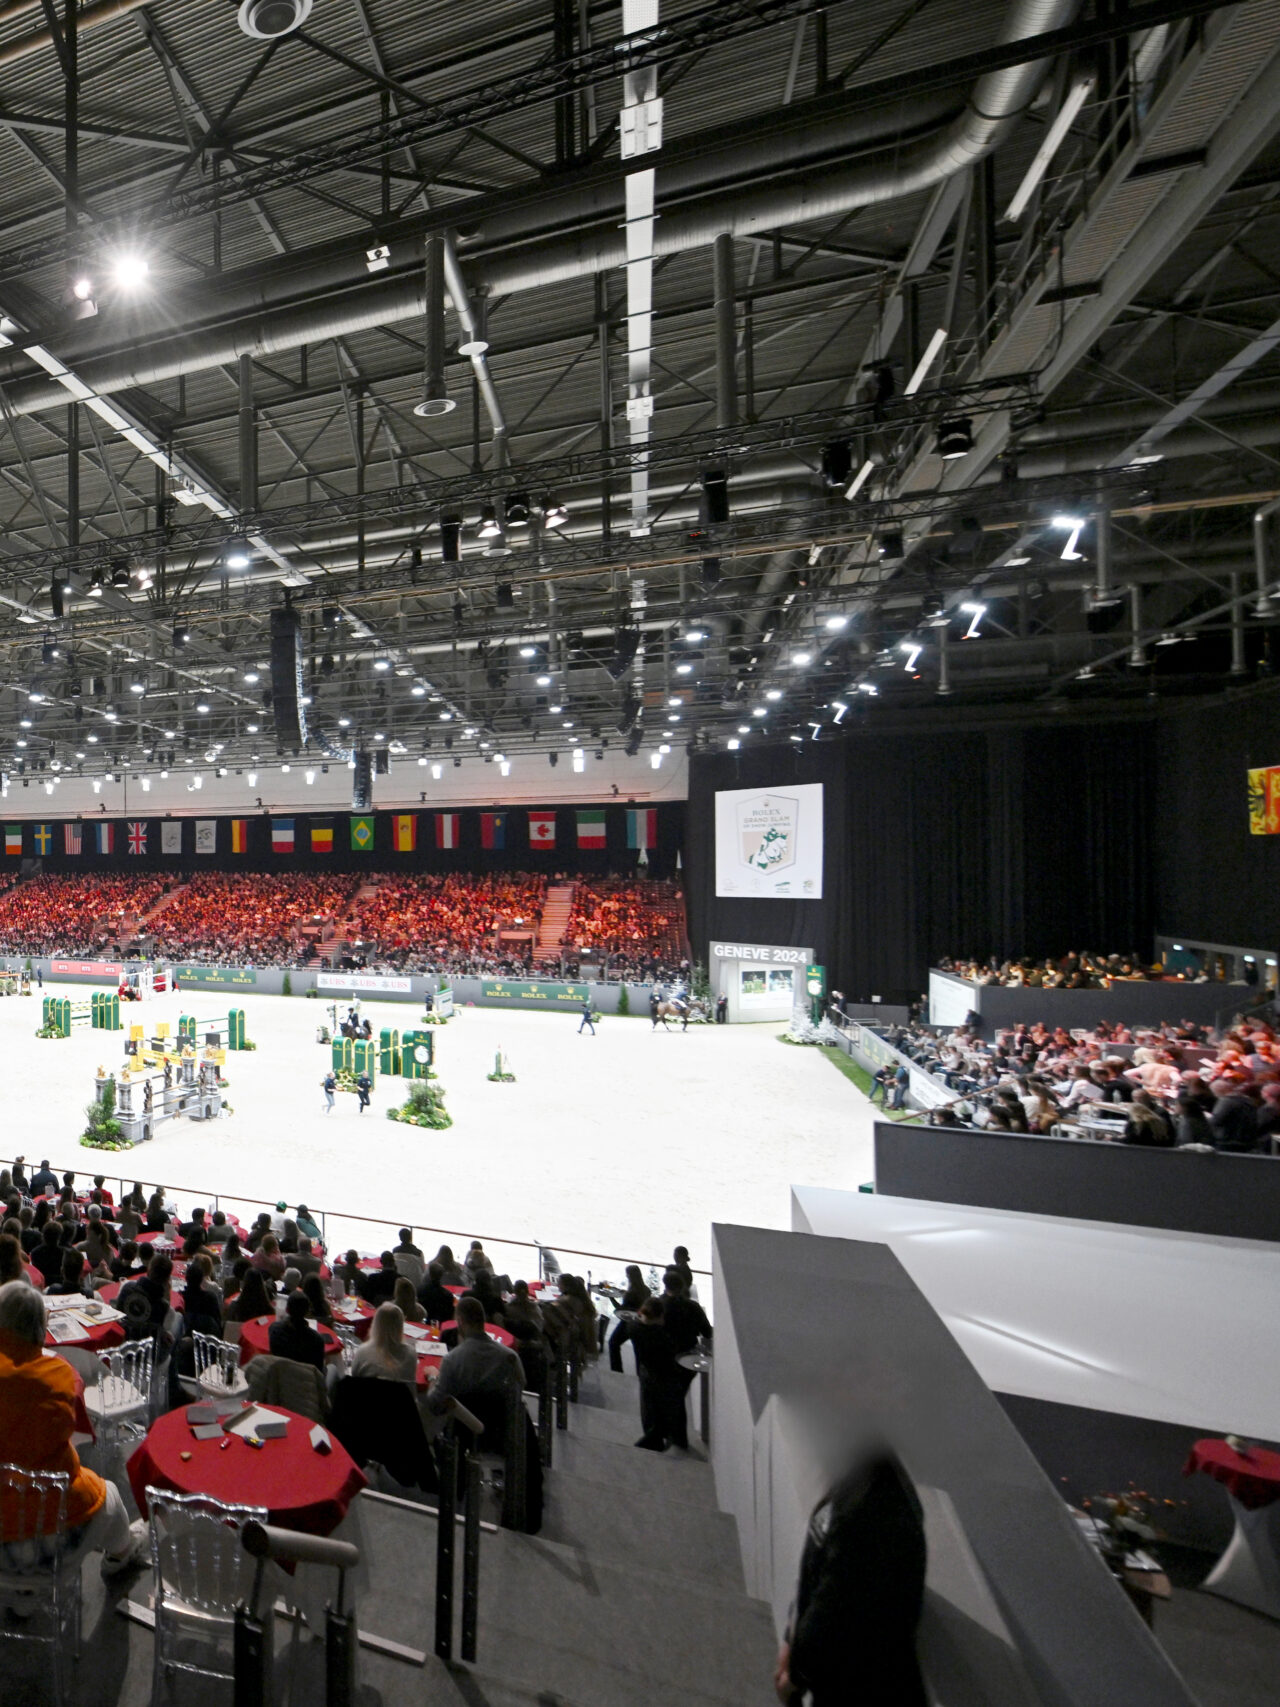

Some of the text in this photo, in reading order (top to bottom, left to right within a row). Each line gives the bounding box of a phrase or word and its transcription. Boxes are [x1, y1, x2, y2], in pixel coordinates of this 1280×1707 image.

[752, 808, 781, 816] ROLEX
[714, 945, 807, 964] GENEVE 2024
[329, 977, 346, 985] UBS
[360, 979, 376, 987] UBS
